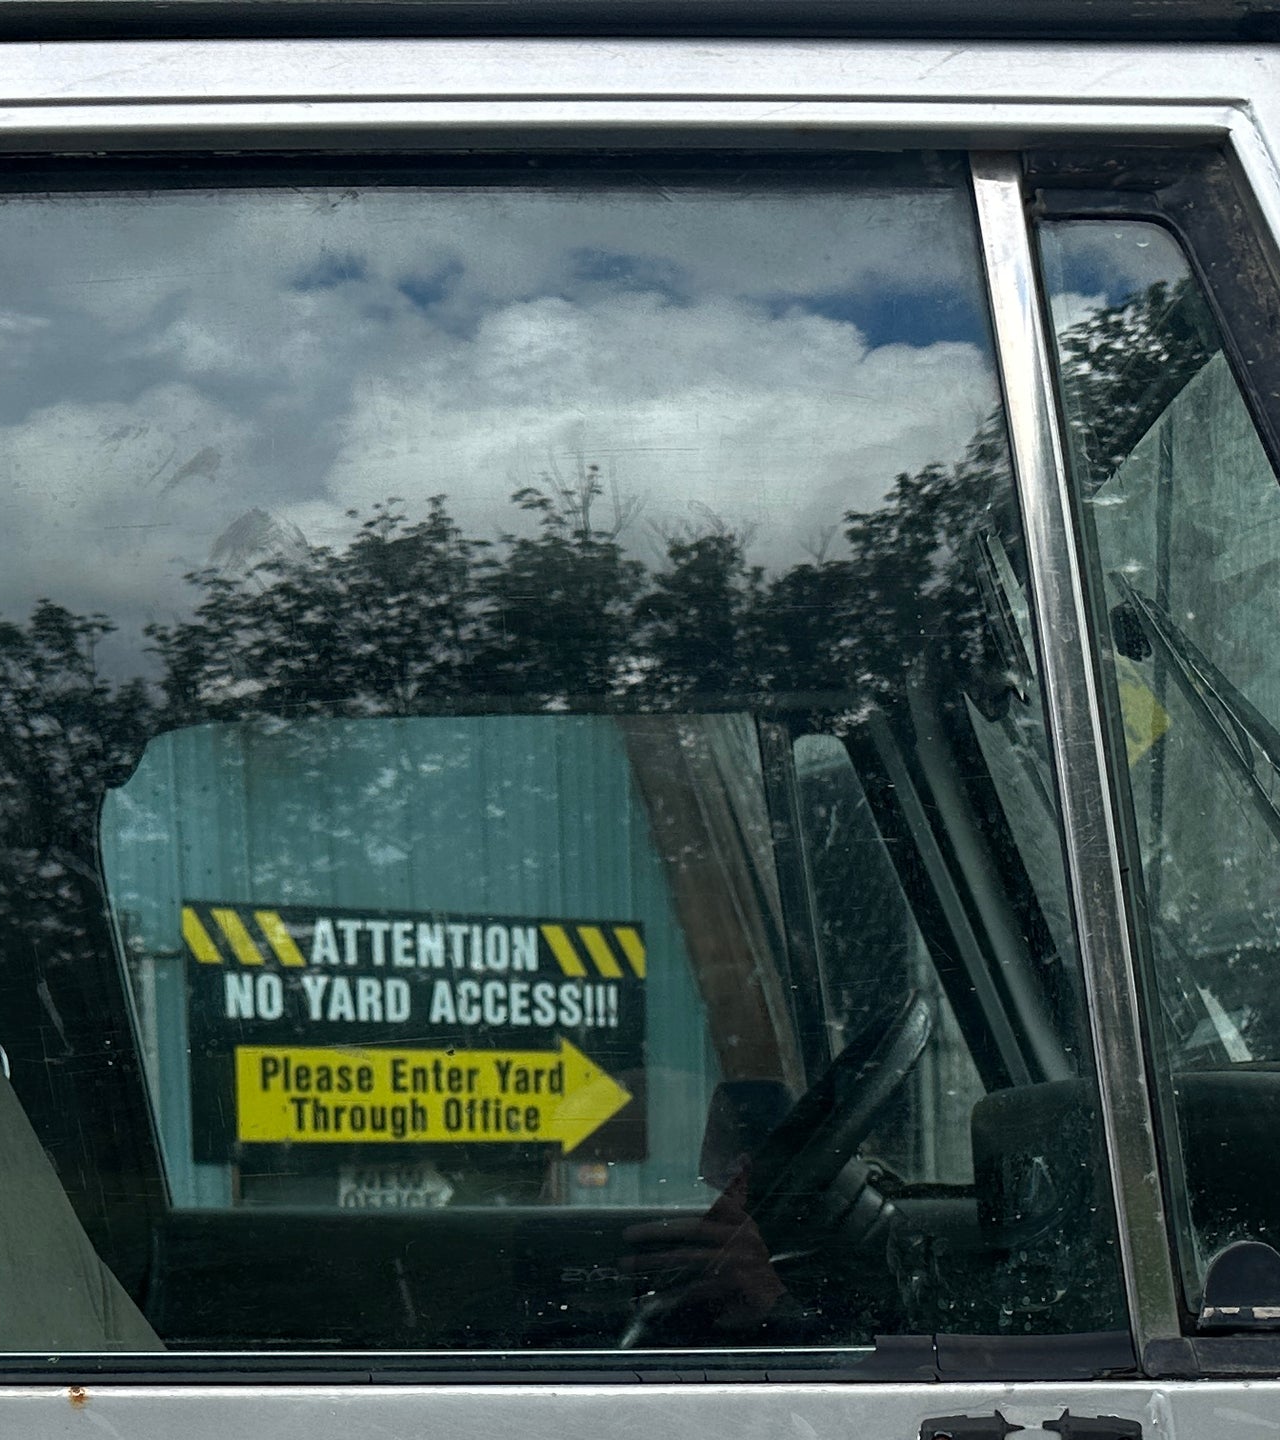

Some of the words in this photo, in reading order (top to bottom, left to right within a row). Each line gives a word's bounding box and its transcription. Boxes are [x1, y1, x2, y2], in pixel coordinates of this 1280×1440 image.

[311, 918, 539, 971] ATTENTION
[226, 973, 283, 1020] NO
[301, 976, 411, 1024] YARD
[430, 981, 619, 1028] ACCESS!!!
[260, 1056, 374, 1094] Please
[391, 1058, 480, 1095] Enter
[495, 1060, 564, 1096] Yard
[291, 1097, 428, 1139] Through
[444, 1098, 540, 1133] Office
